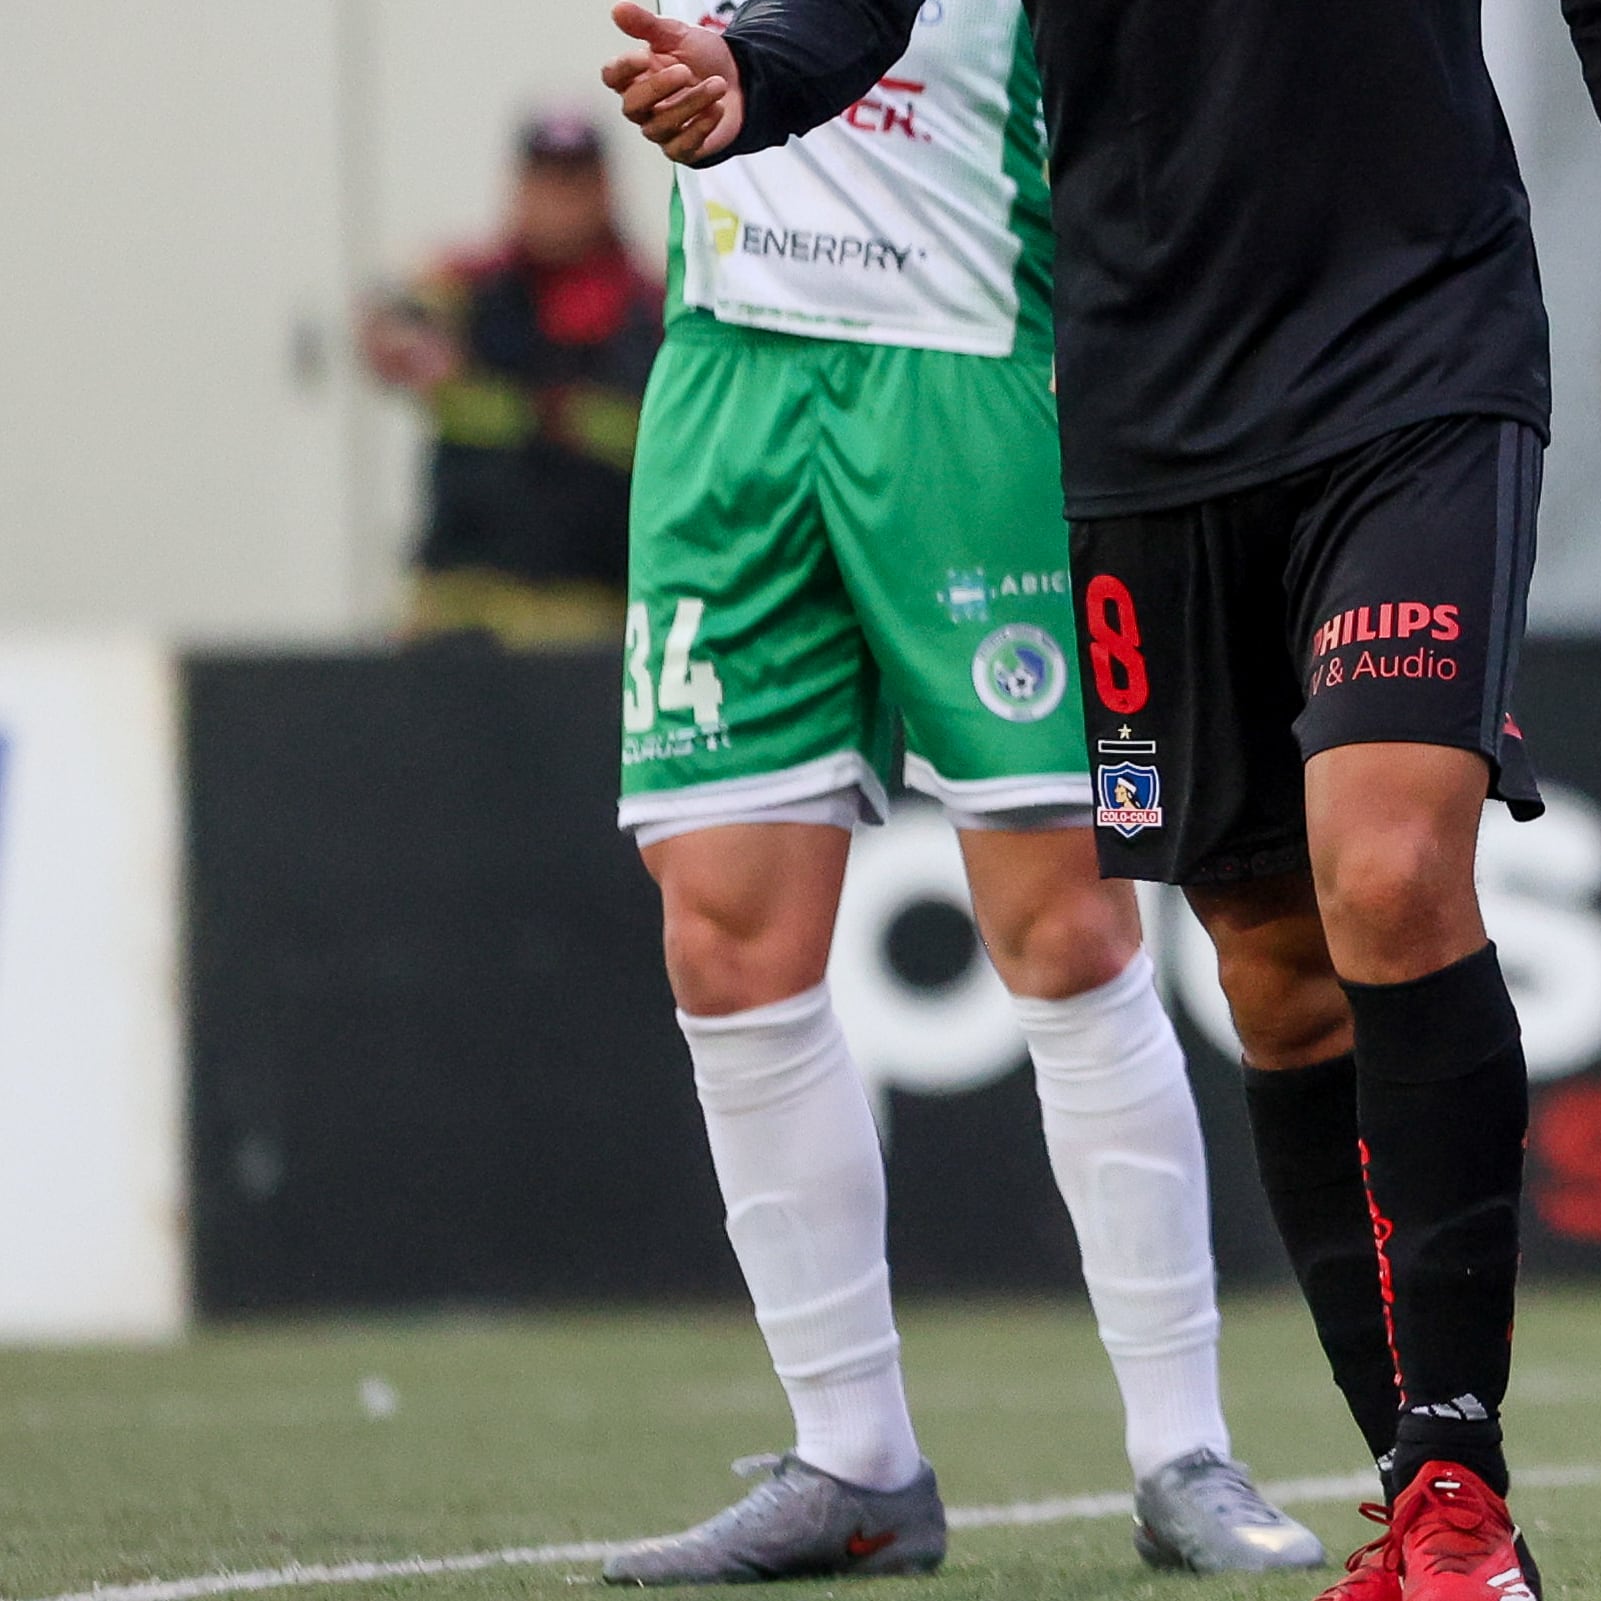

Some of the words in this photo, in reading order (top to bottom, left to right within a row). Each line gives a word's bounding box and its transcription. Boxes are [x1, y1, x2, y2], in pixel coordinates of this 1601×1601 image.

[743, 223, 913, 272] ENERPRY
[1086, 574, 1150, 715] 8
[1313, 601, 1461, 657] PHILIPS
[623, 597, 723, 734] 34
[1325, 657, 1344, 687] &
[1352, 647, 1458, 681] Audio
[1101, 810, 1158, 825] COLO-COLO
